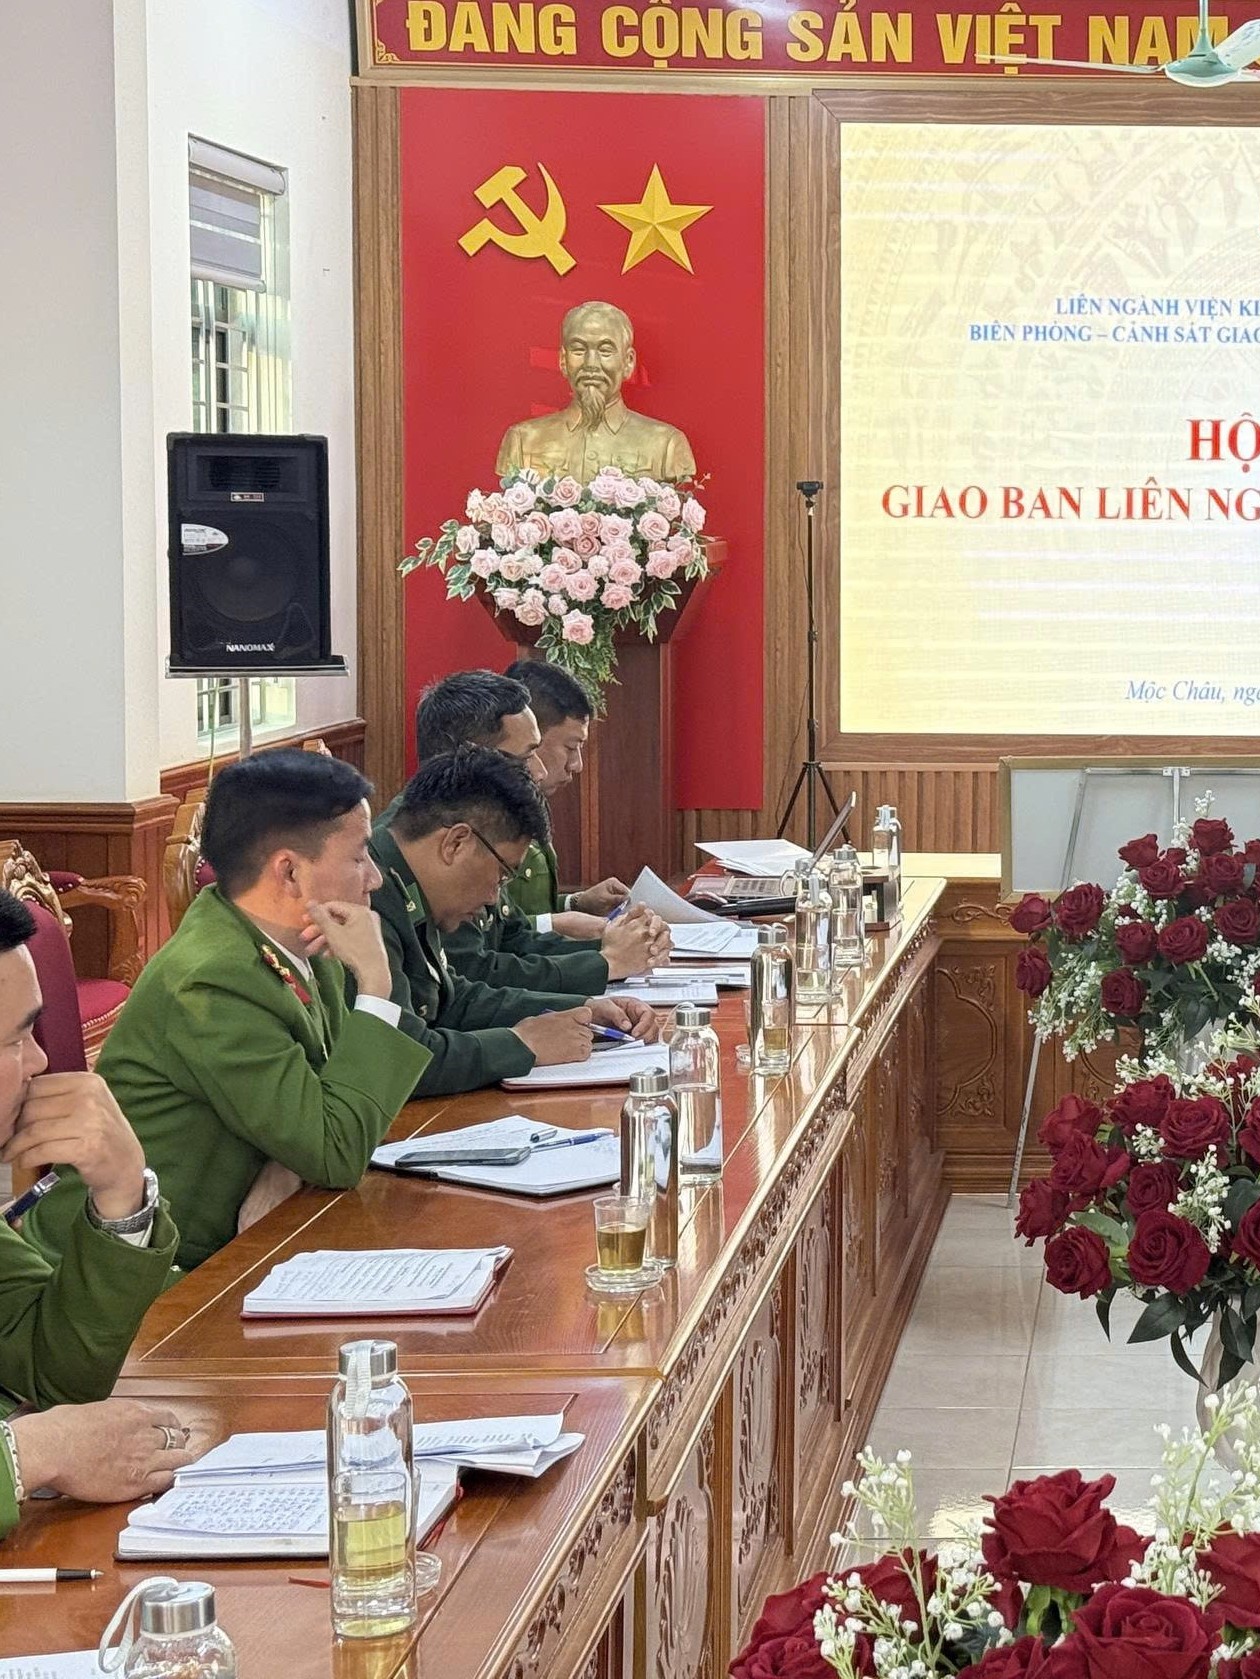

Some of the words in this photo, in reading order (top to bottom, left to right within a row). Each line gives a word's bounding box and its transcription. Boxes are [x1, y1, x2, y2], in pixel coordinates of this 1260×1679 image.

[602, 0, 763, 68] CỘNG
[786, 0, 912, 63] SẢN
[936, 3, 1061, 74] VIỆT
[1056, 293, 1101, 315] LIÊN
[1108, 294, 1179, 316] NGÀNH
[1185, 296, 1232, 321] VIỆN
[970, 320, 1015, 341] BIÊN
[1174, 321, 1211, 343] SÁT
[882, 484, 988, 520] GIAO
[1000, 486, 1083, 520] BAN
[1097, 476, 1192, 521] LIÊN
[1125, 680, 1167, 703] Mộc
[1172, 680, 1226, 704] Châu,
